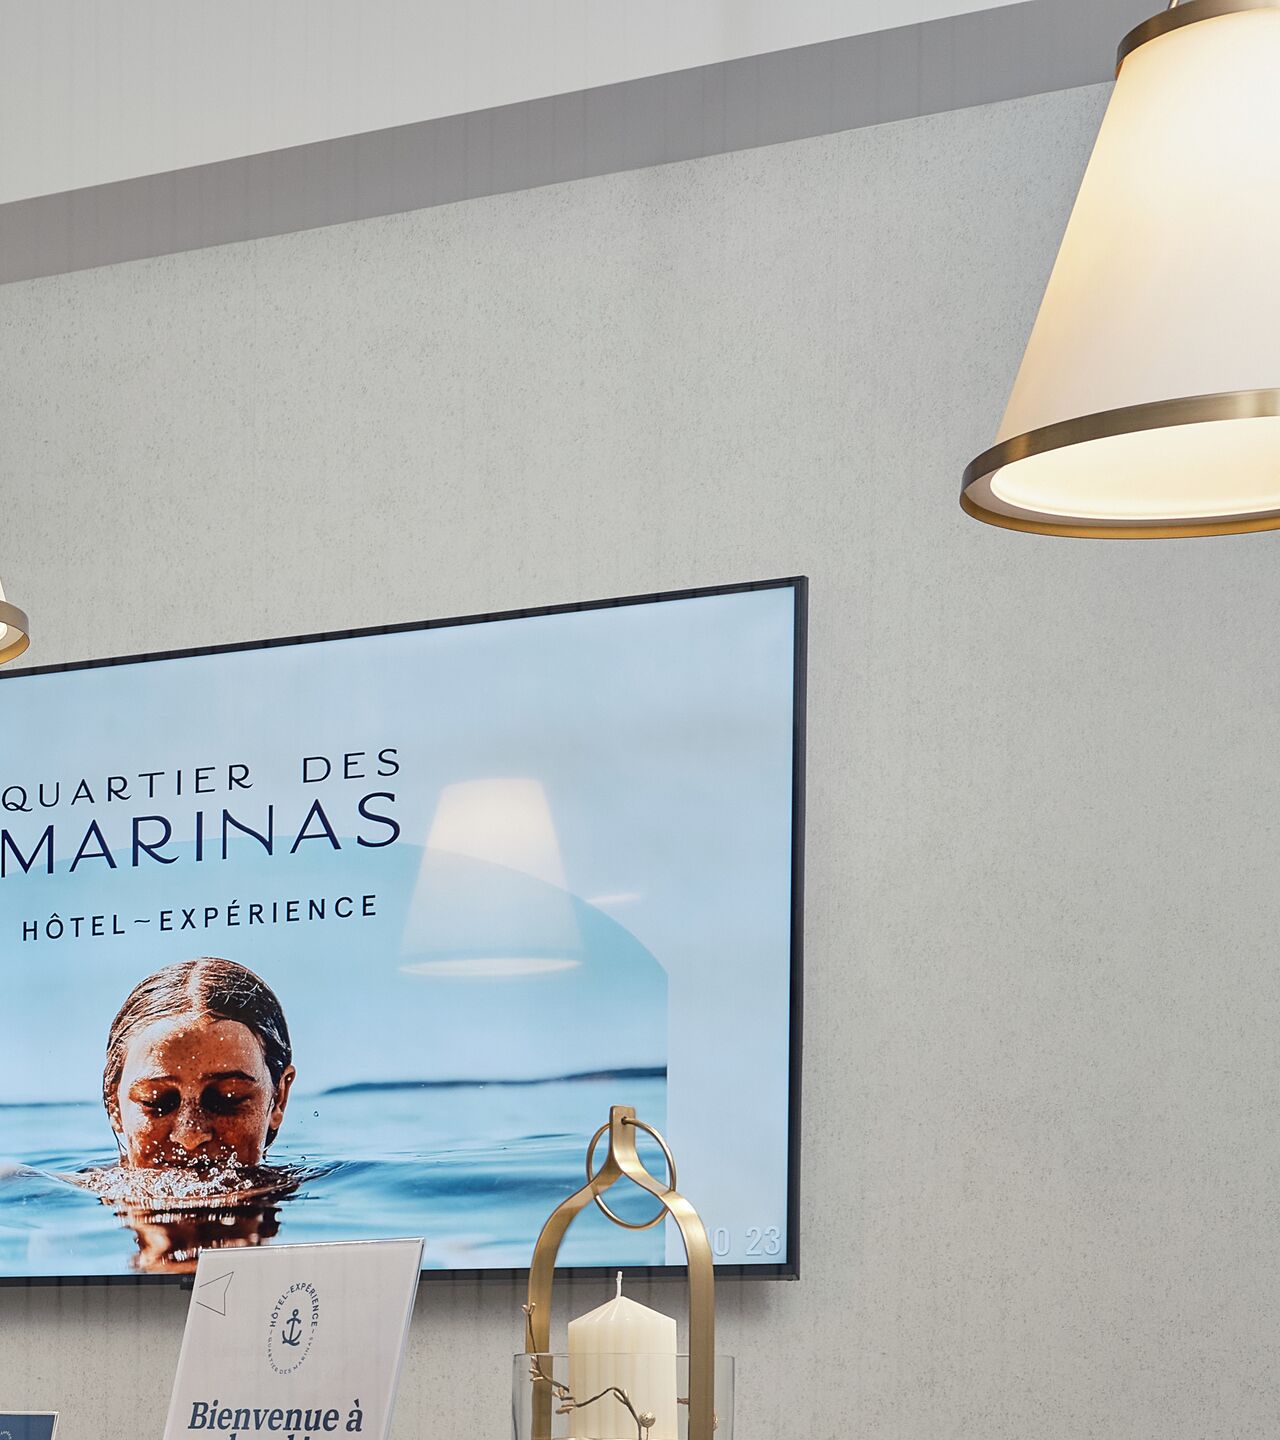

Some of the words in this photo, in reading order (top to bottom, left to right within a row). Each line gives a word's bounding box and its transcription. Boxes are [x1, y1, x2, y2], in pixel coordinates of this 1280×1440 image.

[1, 763, 254, 812] QUARTIER
[303, 748, 401, 783] DES
[0, 792, 401, 878] MARINAS
[746, 1225, 782, 1256] 23
[187, 1399, 340, 1432] Bienvenue
[345, 1398, 363, 1432] à
